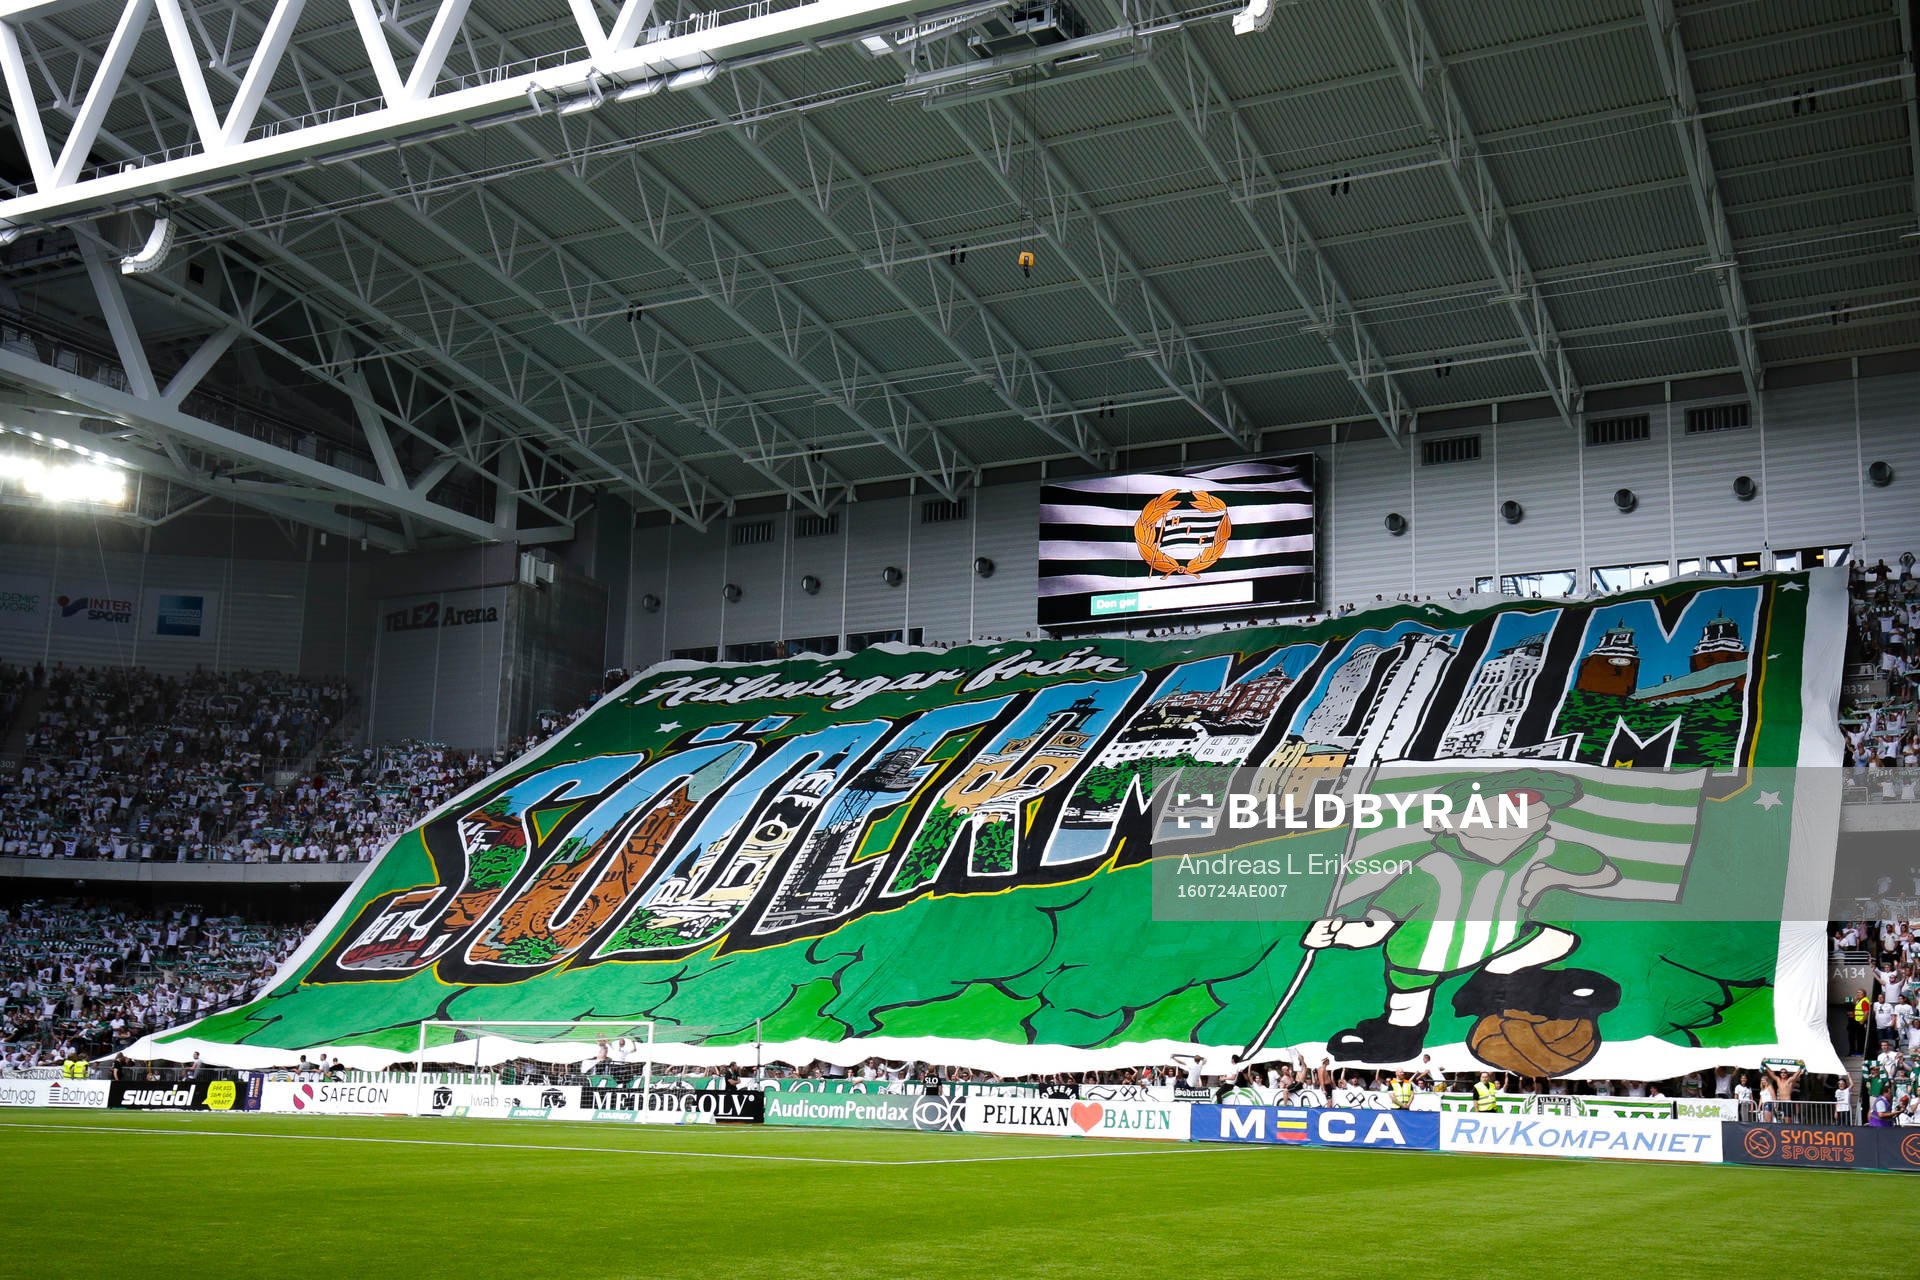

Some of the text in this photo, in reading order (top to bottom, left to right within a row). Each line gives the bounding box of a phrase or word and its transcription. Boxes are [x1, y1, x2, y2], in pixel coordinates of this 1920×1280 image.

[89, 597, 132, 612] INTER
[87, 610, 131, 624] SPORT
[385, 601, 498, 632] TELE2 Arena
[634, 646, 1129, 709] Hälsningar från
[325, 582, 1766, 976] SÖDERMALM
[1833, 967, 1866, 979] A134
[924, 1077, 939, 1085] SLO
[62, 1087, 105, 1105] Botrygg
[121, 1084, 197, 1106] swedol
[768, 1098, 909, 1121] AudicomPendax
[983, 1104, 1171, 1130] PELIKAN BAJEN
[1219, 1108, 1406, 1145] MECA
[1780, 1129, 1855, 1147] SYNSAM
[1781, 1145, 1855, 1163] SPORTS
